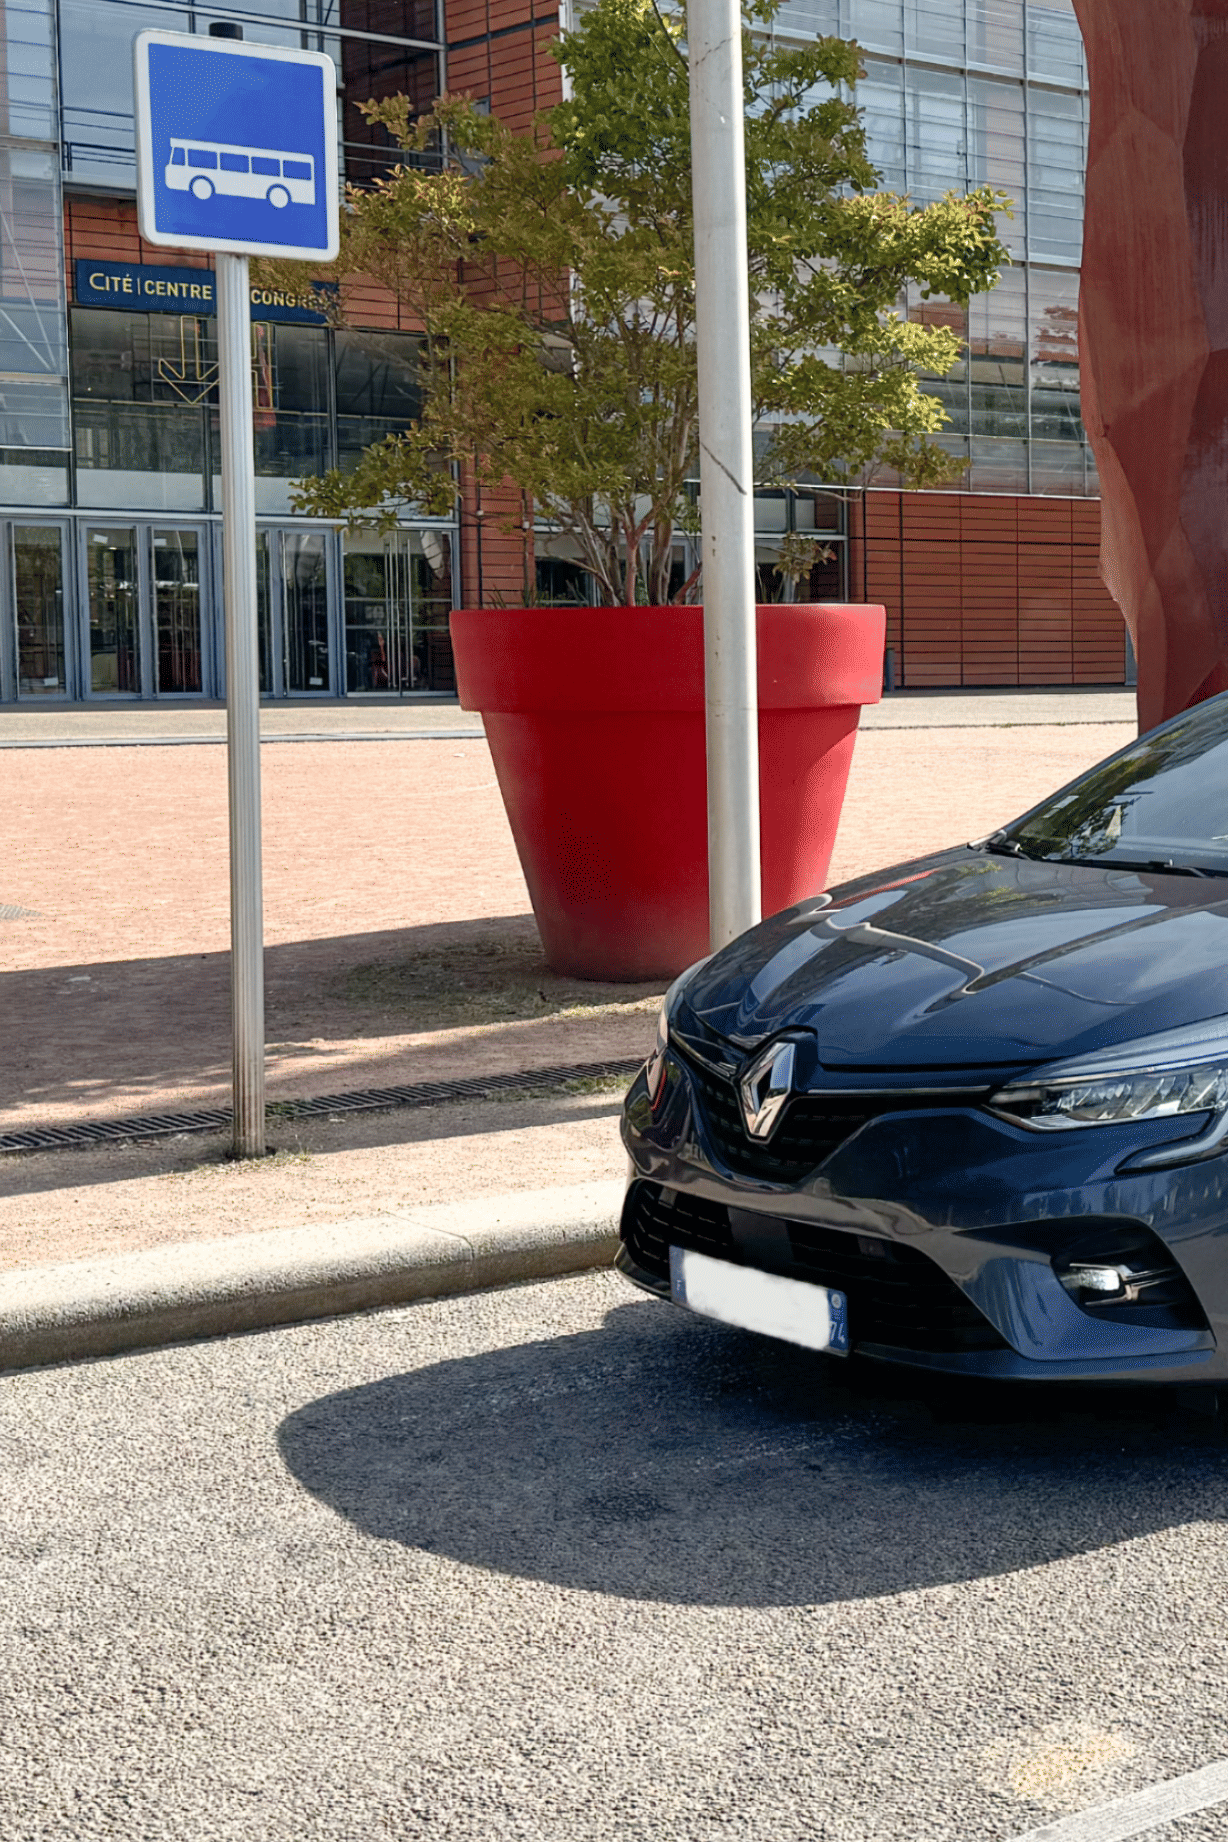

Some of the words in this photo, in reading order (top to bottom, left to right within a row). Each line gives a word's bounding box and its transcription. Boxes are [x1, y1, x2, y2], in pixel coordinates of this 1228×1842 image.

[144, 279, 213, 300] CENTRE
[250, 288, 322, 311] CONGR
[830, 1320, 846, 1344] 74
